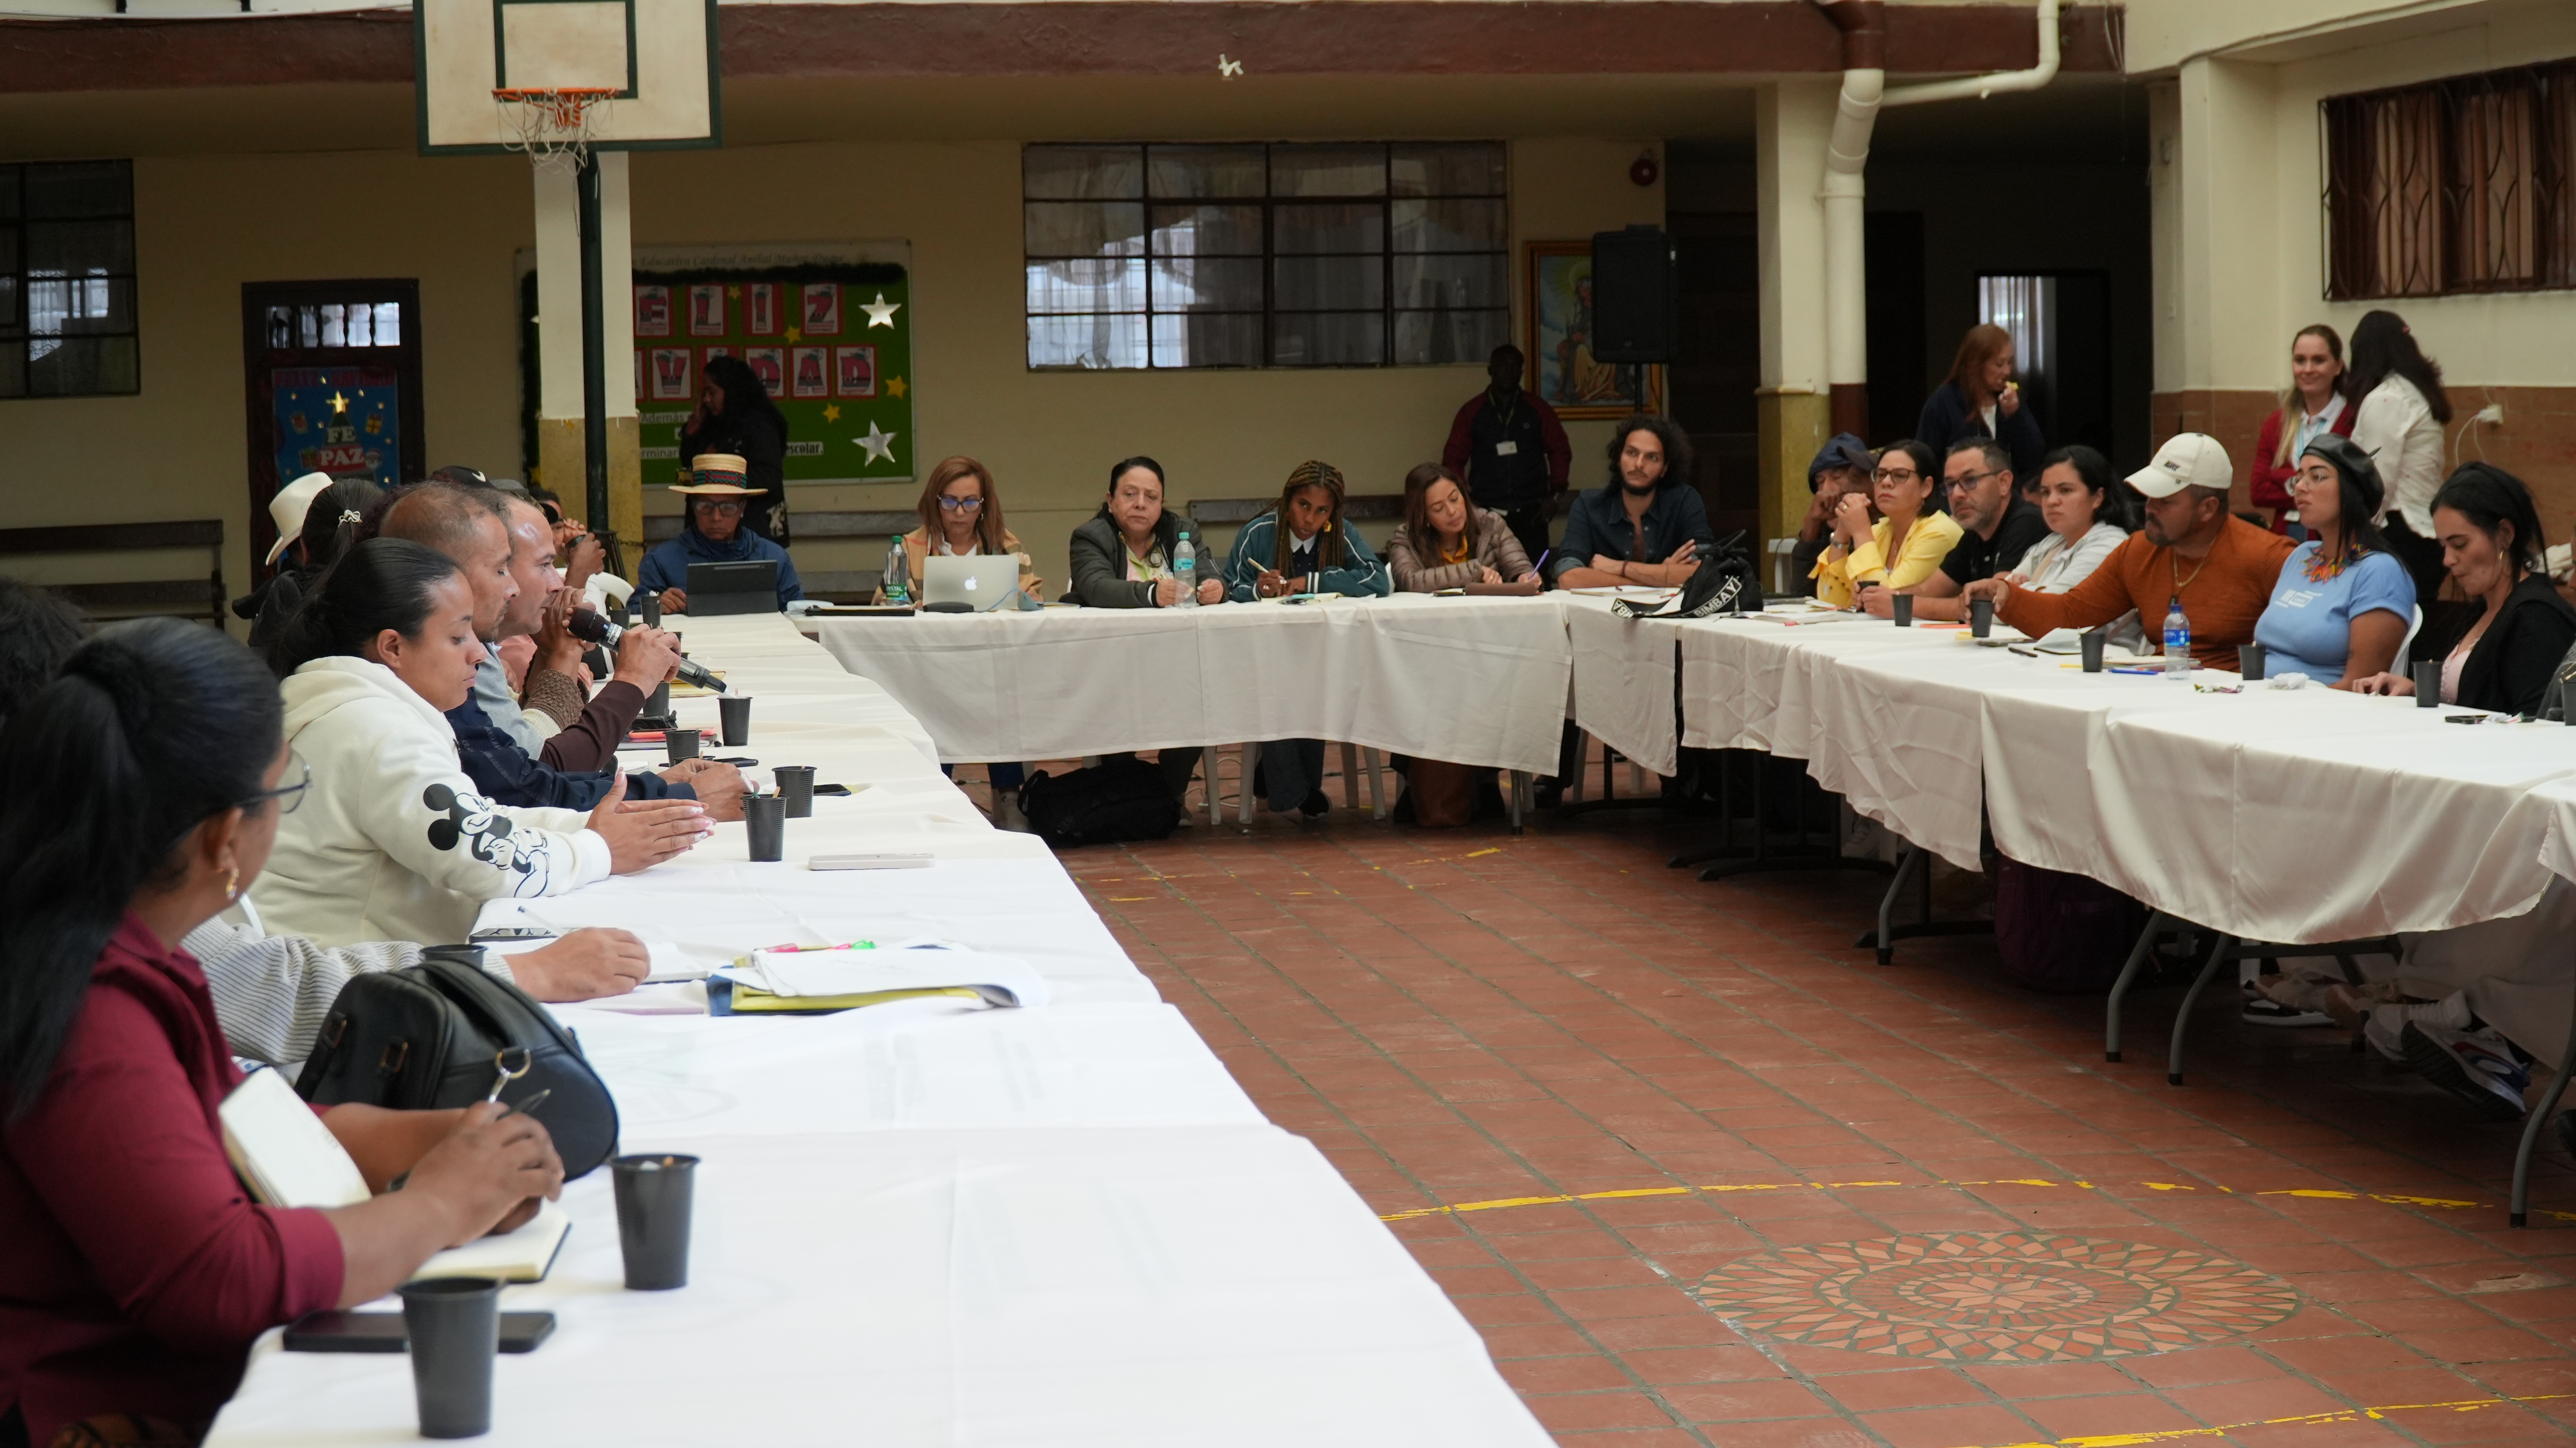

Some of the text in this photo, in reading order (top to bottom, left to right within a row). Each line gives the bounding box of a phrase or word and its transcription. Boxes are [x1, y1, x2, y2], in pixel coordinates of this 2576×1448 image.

[639, 288, 835, 334] ELIZ
[634, 352, 872, 395] VDAD
[327, 426, 355, 443] FE
[320, 448, 365, 466] PAZ
[642, 449, 677, 458] rminar
